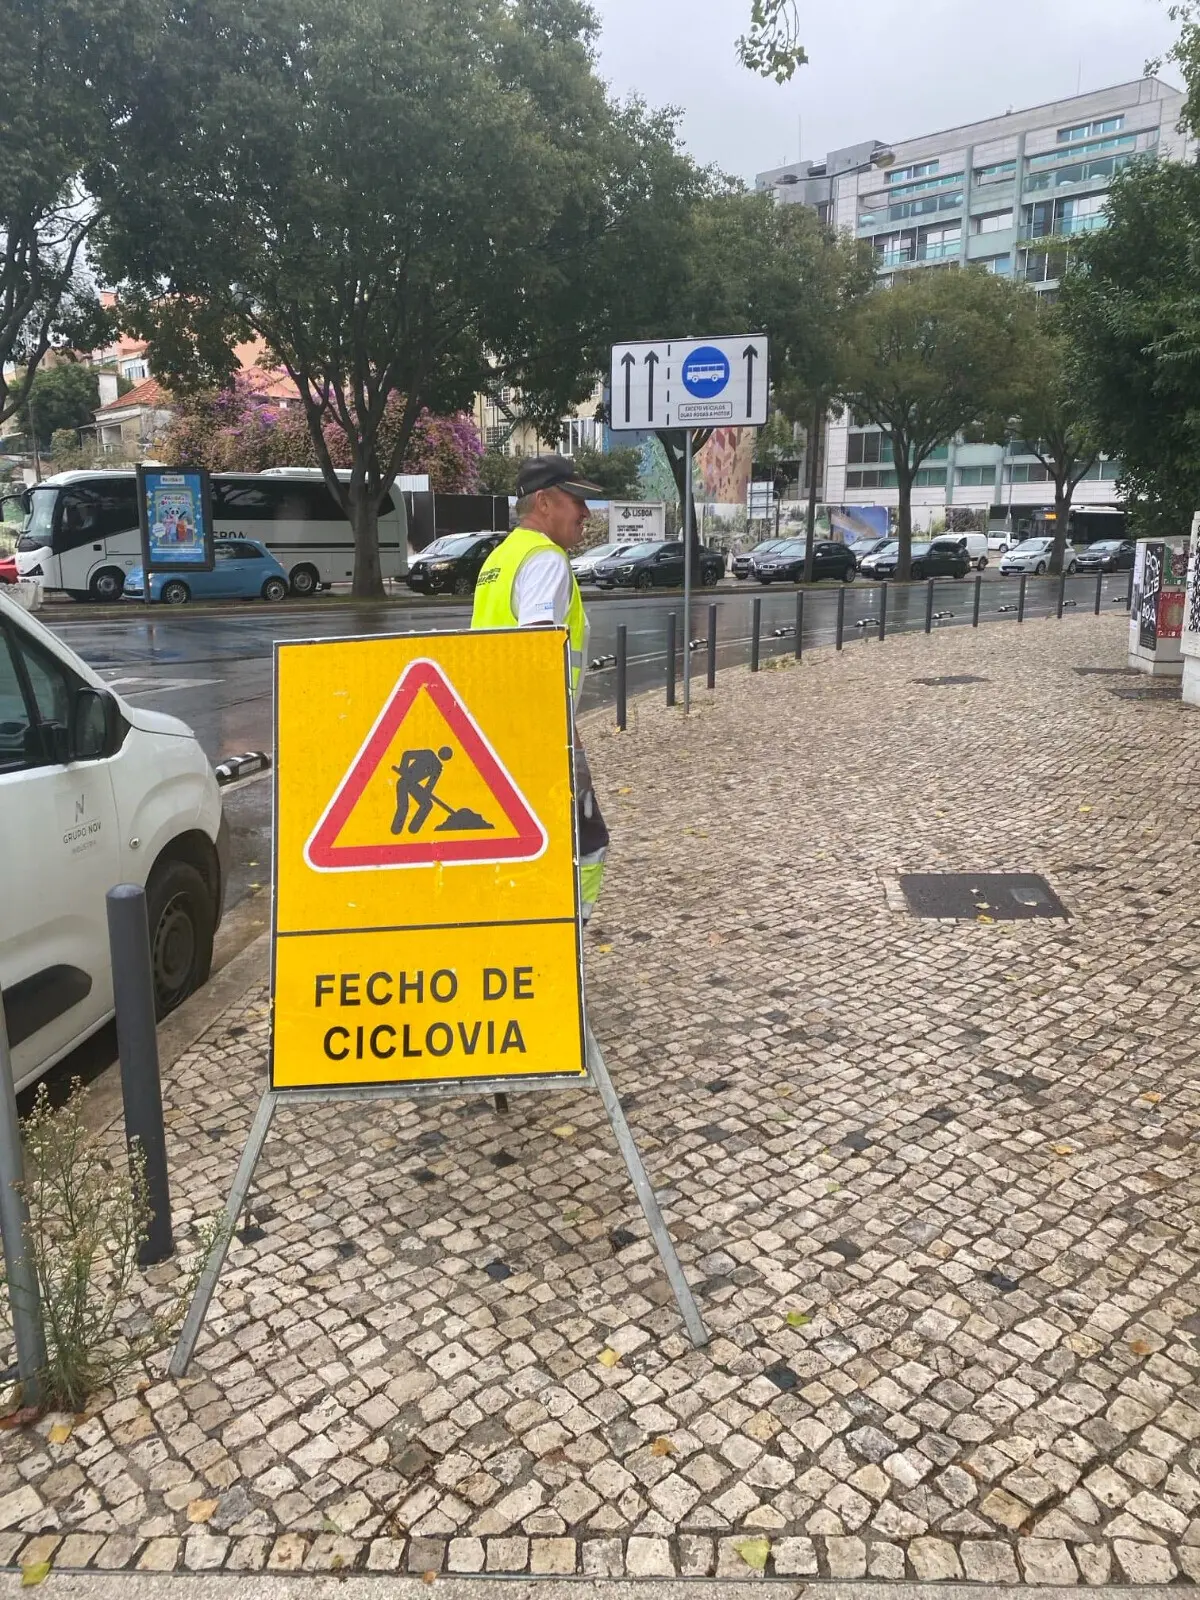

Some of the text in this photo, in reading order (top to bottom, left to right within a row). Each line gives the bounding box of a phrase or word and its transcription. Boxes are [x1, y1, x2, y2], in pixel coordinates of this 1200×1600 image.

[63, 827, 87, 844] GRUPO
[315, 966, 535, 1008] FECHO DE
[323, 1019, 528, 1061] CICLOVIA
